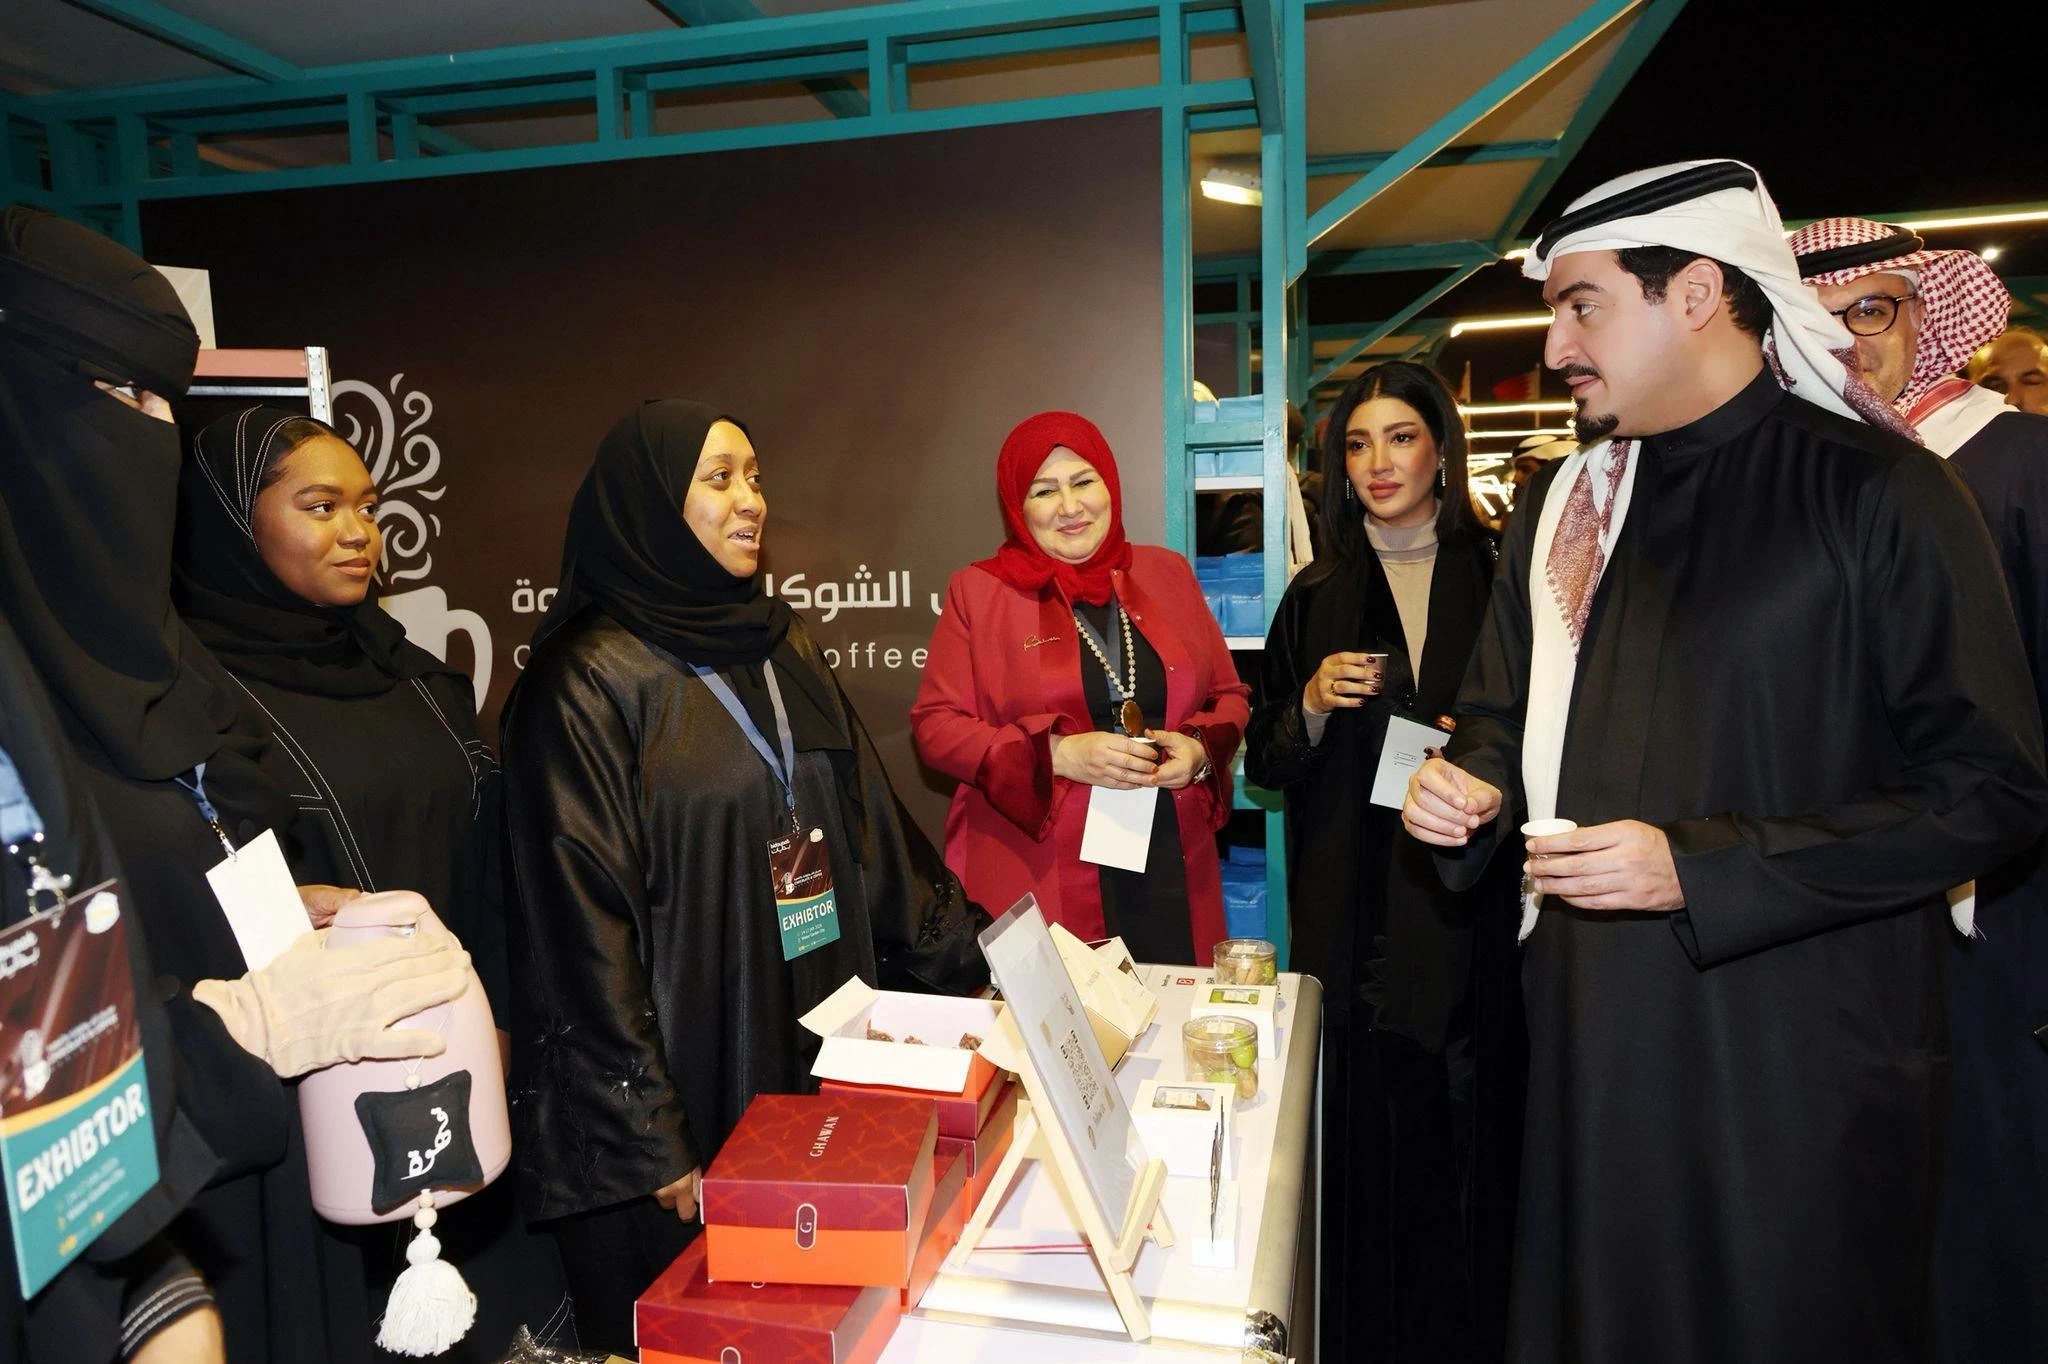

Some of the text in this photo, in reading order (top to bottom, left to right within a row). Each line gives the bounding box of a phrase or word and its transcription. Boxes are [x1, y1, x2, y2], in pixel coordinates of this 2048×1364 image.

[823, 642, 928, 669] offee
[782, 899, 834, 931] EXHIBTOR
[16, 1082, 146, 1212] EXHIBTOR
[810, 1116, 839, 1157] GHAWAN
[800, 1222, 813, 1233] G
